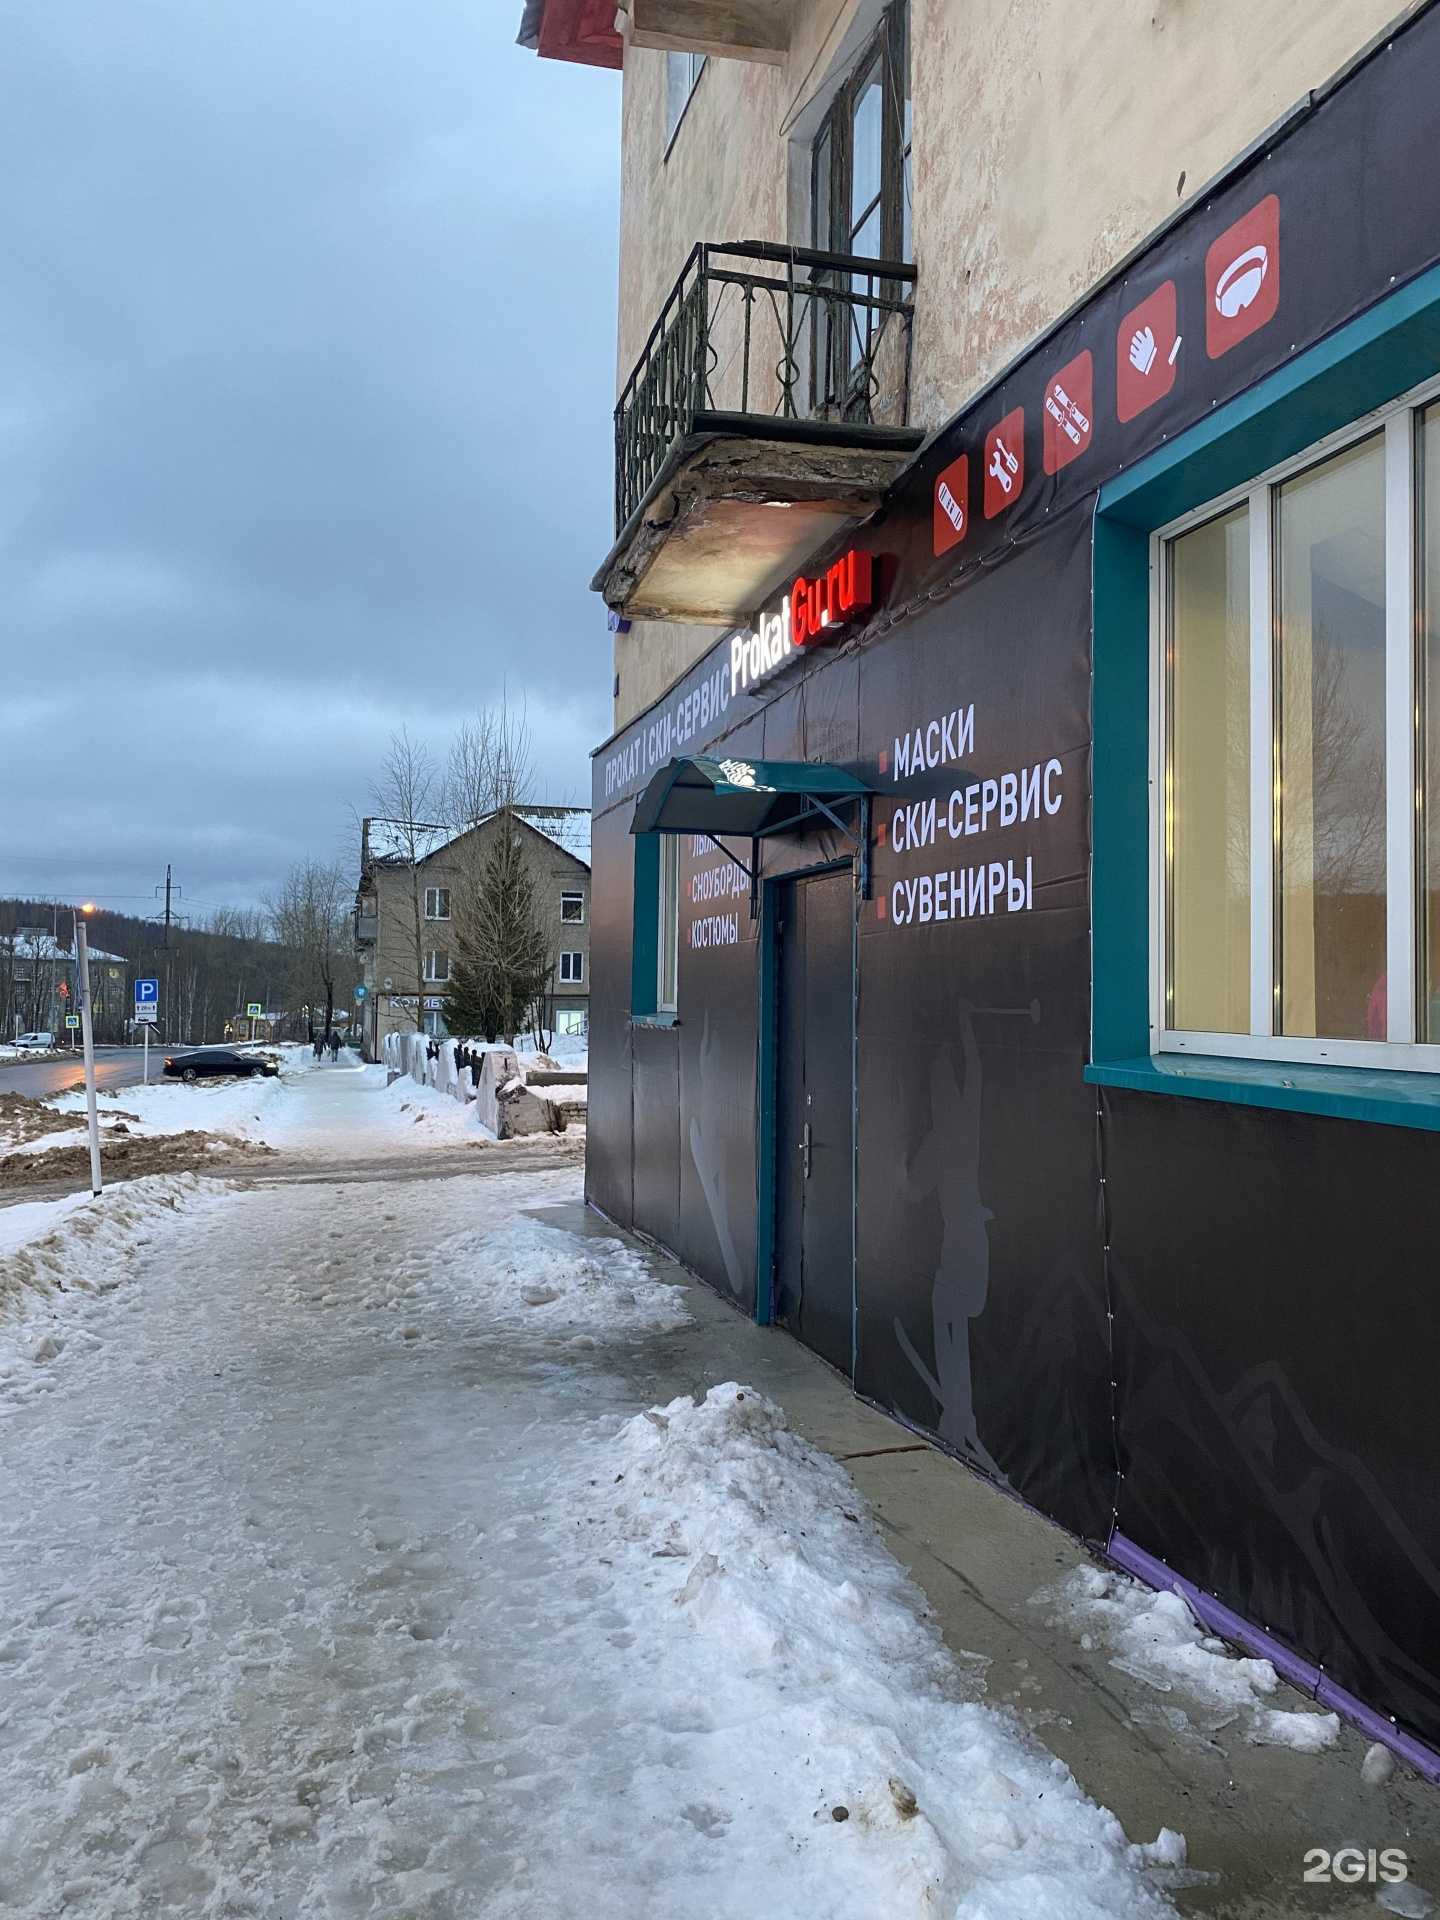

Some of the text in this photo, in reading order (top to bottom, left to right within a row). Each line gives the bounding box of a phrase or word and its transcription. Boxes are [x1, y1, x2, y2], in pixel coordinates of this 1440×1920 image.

[605, 737, 641, 797] ПРОКАТ
[648, 663, 730, 766] СКИ-СЕРВИС
[893, 703, 975, 782] МАСКИ
[892, 758, 1063, 853] СКИ-СЕРВИС
[691, 858, 750, 904] СНОУБОРДЫ
[892, 856, 1033, 926] СУВЕНИРЫ
[691, 911, 739, 949] КОСТЮМЫ
[141, 982, 154, 1001] P
